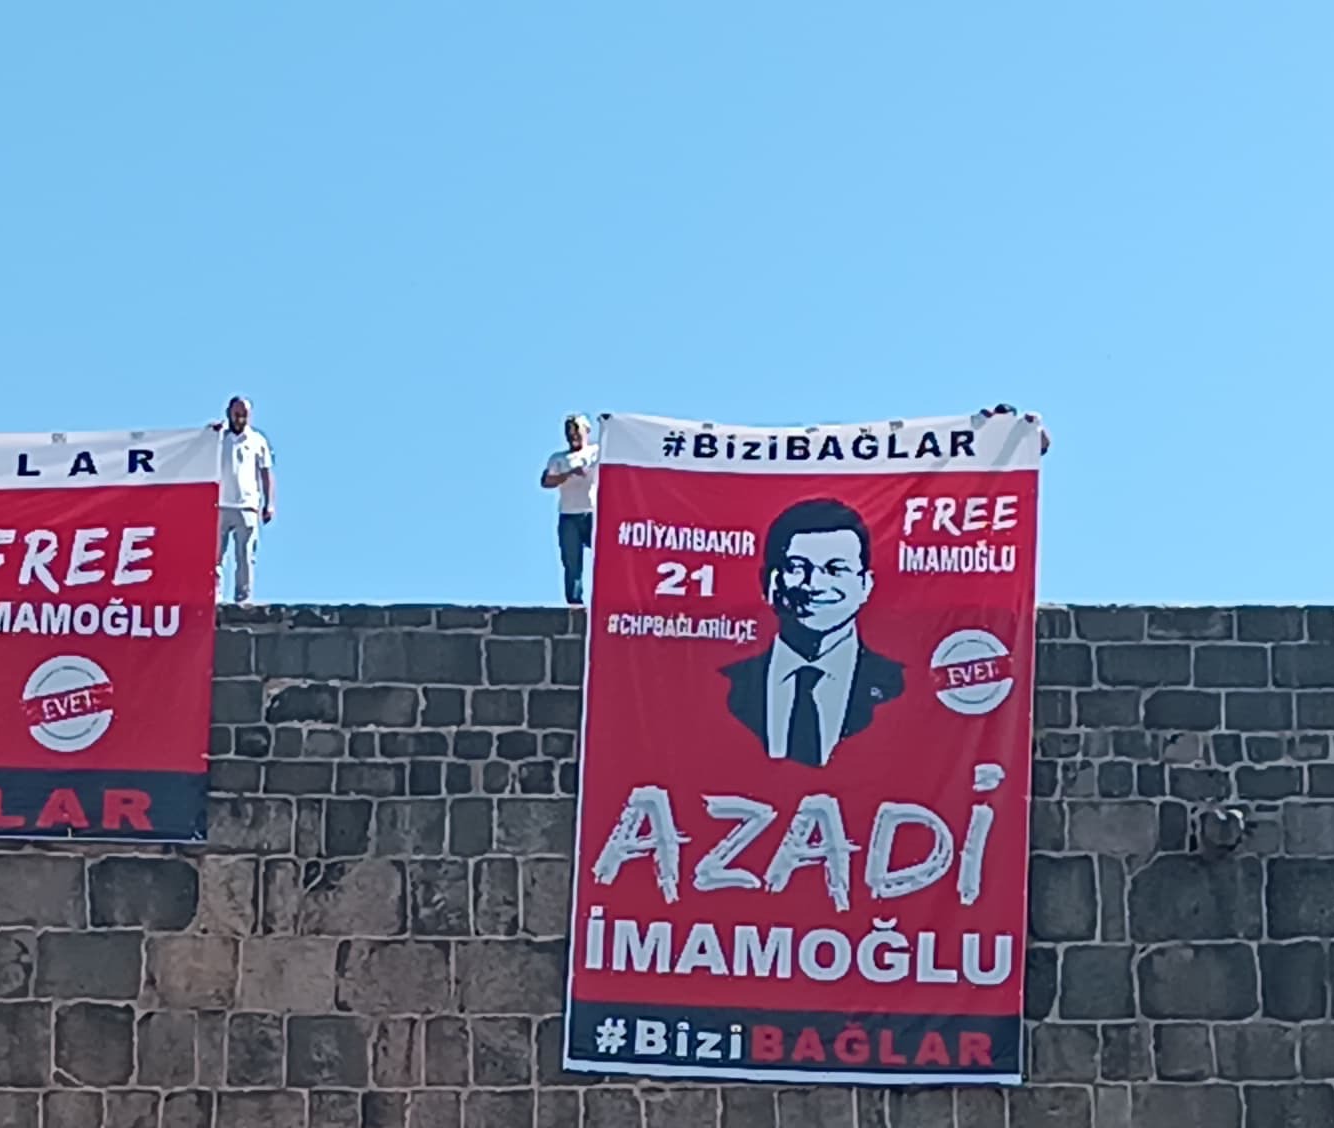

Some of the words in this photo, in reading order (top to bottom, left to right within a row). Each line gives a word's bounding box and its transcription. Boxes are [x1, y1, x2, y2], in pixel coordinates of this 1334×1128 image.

[662, 425, 977, 462] #BiziBAĞLAR
[903, 496, 1019, 537] FREE
[618, 519, 756, 557] #DİYARBAKIR
[898, 539, 1016, 575] İMAMOĞLU
[655, 561, 715, 597] 21
[947, 660, 996, 686] EVET
[42, 689, 91, 720] EVET
[591, 763, 1006, 913] AZADİ
[584, 906, 1014, 987] İMAMOĞLU
[594, 1017, 994, 1068] #BiziBAĞLAR
